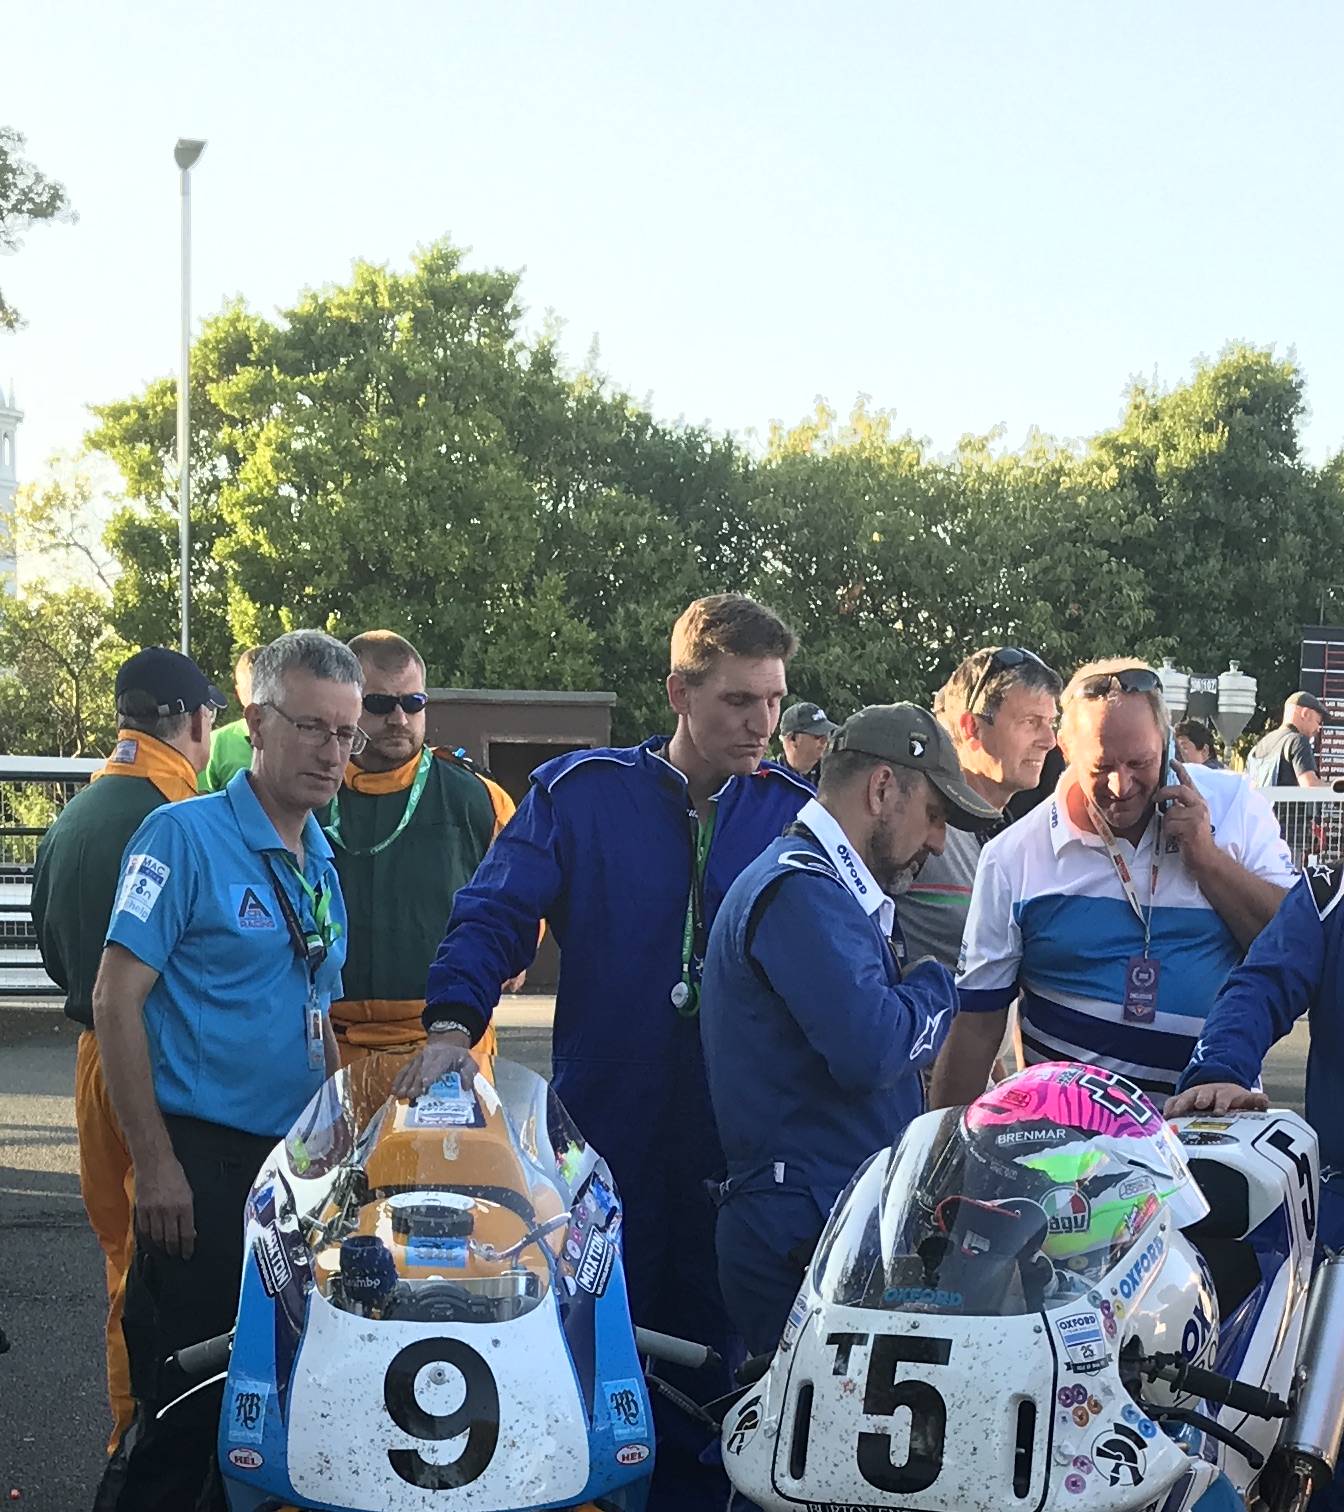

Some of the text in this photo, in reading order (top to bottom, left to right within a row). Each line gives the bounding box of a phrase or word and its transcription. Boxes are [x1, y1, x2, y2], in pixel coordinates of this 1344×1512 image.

[143, 857, 166, 876] MAC
[837, 844, 868, 896] OXFORD
[128, 900, 148, 919] help
[996, 1128, 1066, 1144] BRENMAR
[265, 1224, 291, 1291] MAXTON
[579, 1228, 606, 1290] MAXTON
[1118, 1233, 1165, 1300] OXFORD
[1059, 1315, 1097, 1330] OXFORD
[1079, 1344, 1094, 1359] 25
[383, 1337, 500, 1490] 9
[233, 1455, 258, 1467] HEL
[620, 1451, 645, 1463] HEL
